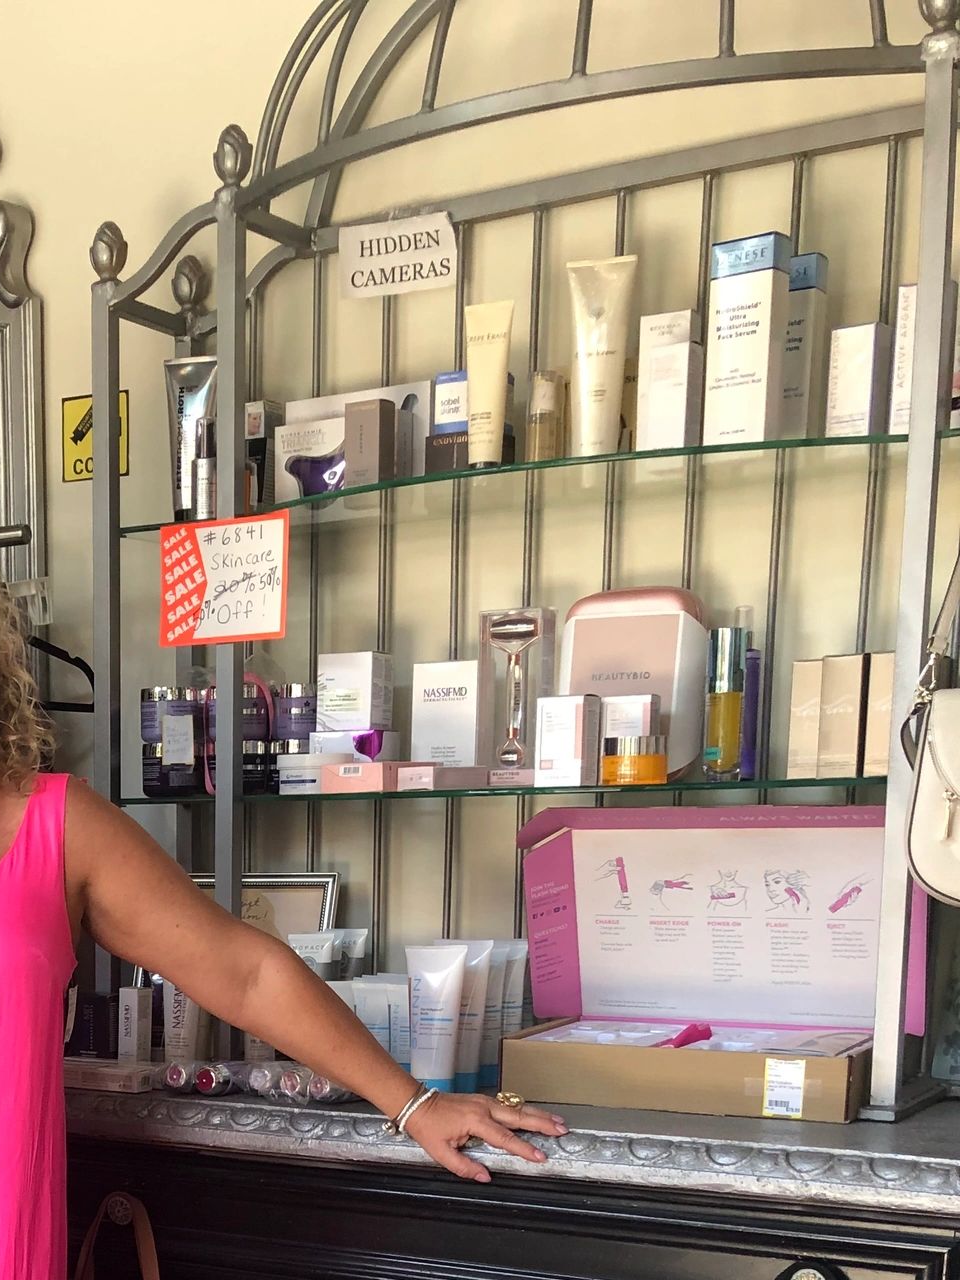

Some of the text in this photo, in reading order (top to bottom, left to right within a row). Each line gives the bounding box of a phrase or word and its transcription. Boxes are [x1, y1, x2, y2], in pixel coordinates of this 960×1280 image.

[359, 229, 441, 258] HIDDEN
[722, 246, 769, 265] ENESE
[351, 257, 451, 289] CAMERAS
[734, 329, 758, 338] Serum
[163, 527, 188, 550] SALE
[164, 540, 193, 567] SALE
[165, 554, 199, 585] SALE
[165, 568, 206, 606] SALE
[167, 594, 201, 625] SALE
[167, 616, 196, 642] SALE
[591, 671, 651, 681] BEAUTYBIO
[423, 686, 468, 698] NASSIFMD
